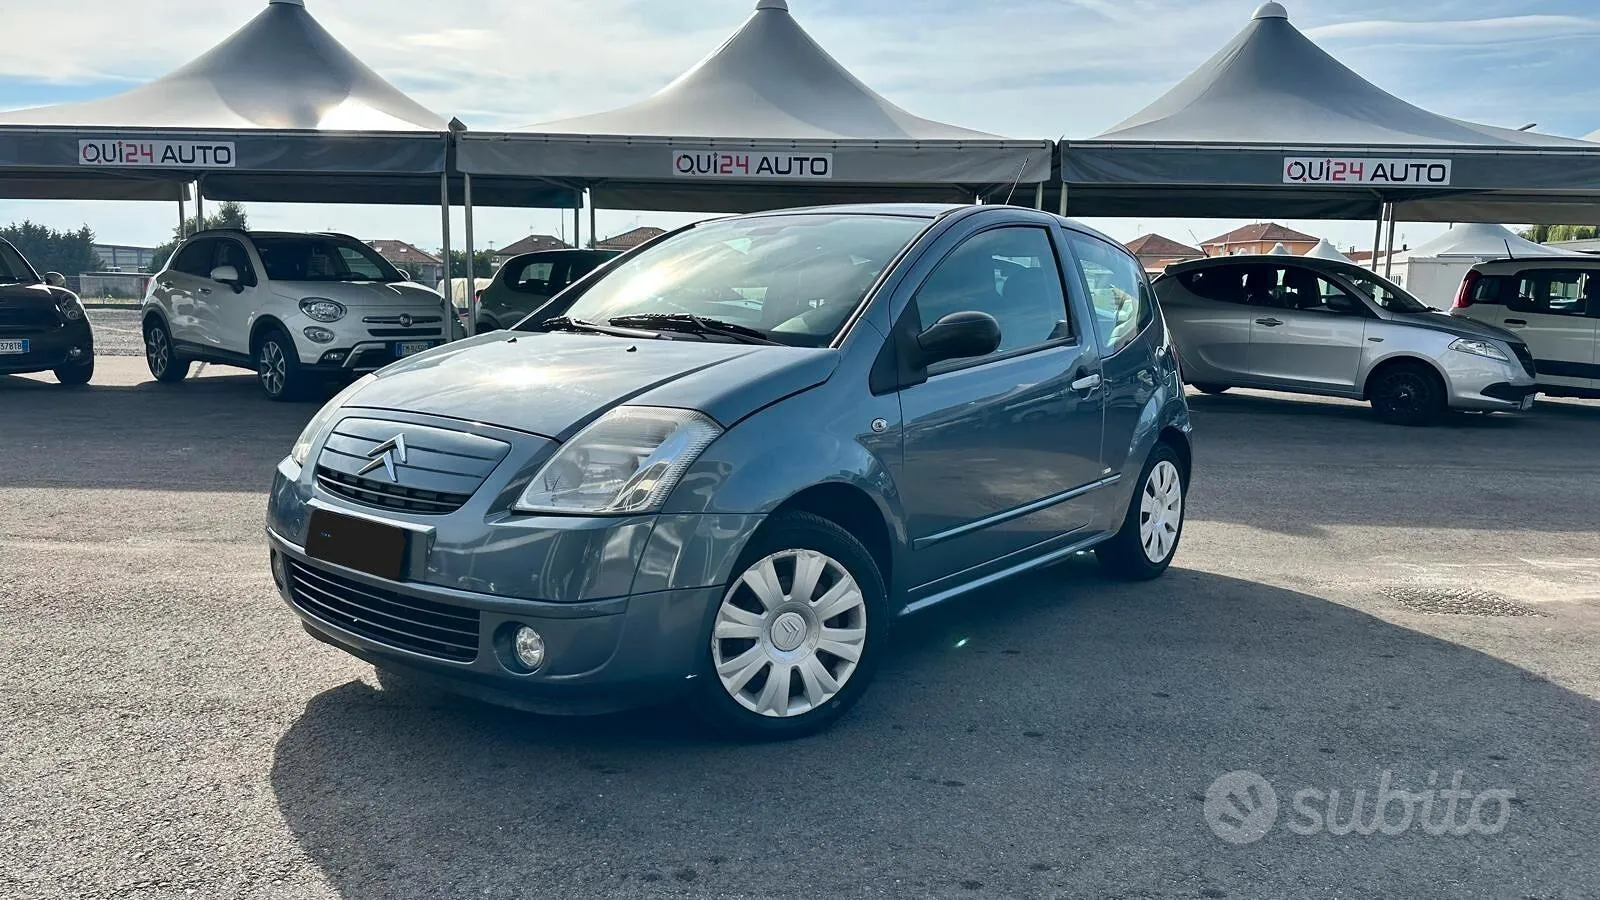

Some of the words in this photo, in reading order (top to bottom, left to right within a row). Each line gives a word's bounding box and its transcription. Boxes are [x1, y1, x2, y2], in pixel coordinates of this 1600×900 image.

[161, 145, 231, 164] AUTO
[756, 156, 828, 175] AUTO
[1370, 163, 1446, 182] AUTO
